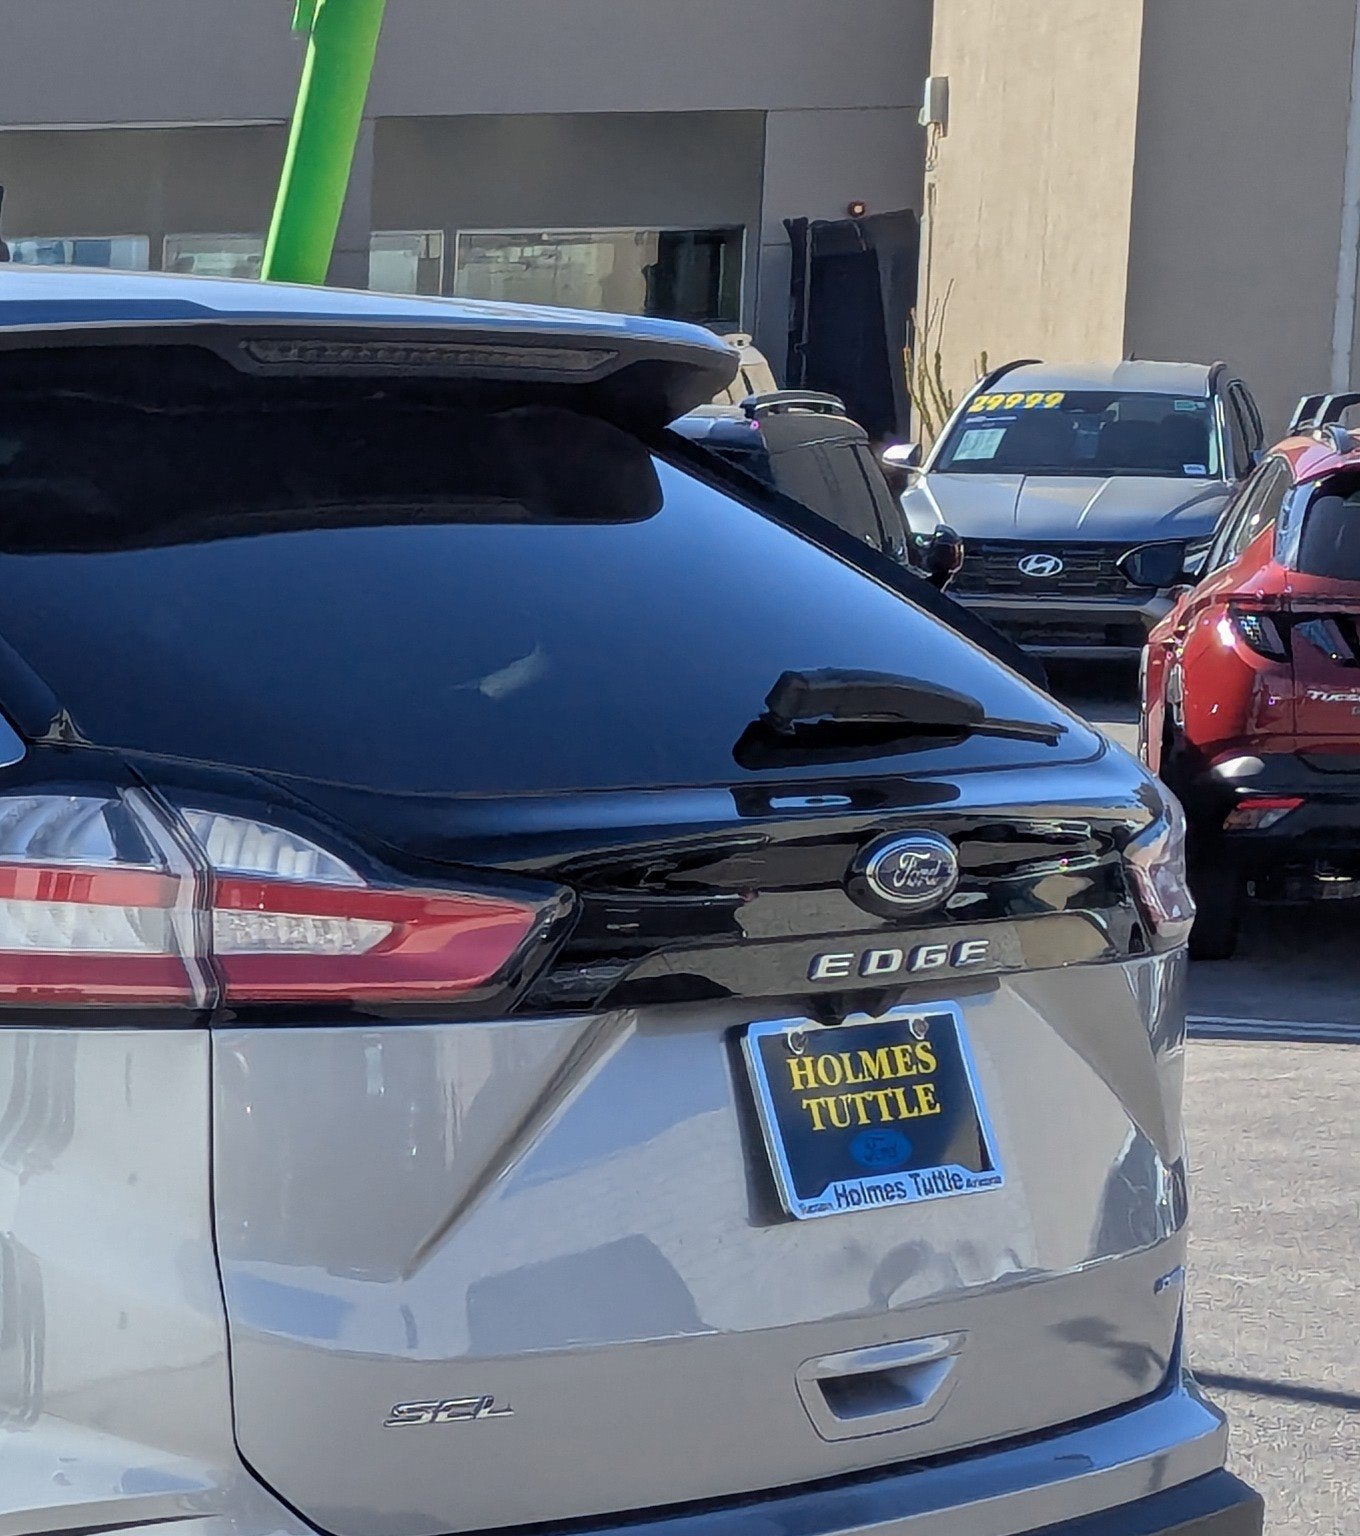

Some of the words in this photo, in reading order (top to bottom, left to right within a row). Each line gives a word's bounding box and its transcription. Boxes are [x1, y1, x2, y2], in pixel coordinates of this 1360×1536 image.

[893, 852, 942, 888] Ford
[809, 940, 990, 981] EDGE
[786, 1040, 938, 1091] HOLMES
[801, 1083, 942, 1131] TUTTLE
[833, 1178, 908, 1209] Holmes
[908, 1167, 964, 1197] Tuttle
[383, 1395, 516, 1428] SEL
